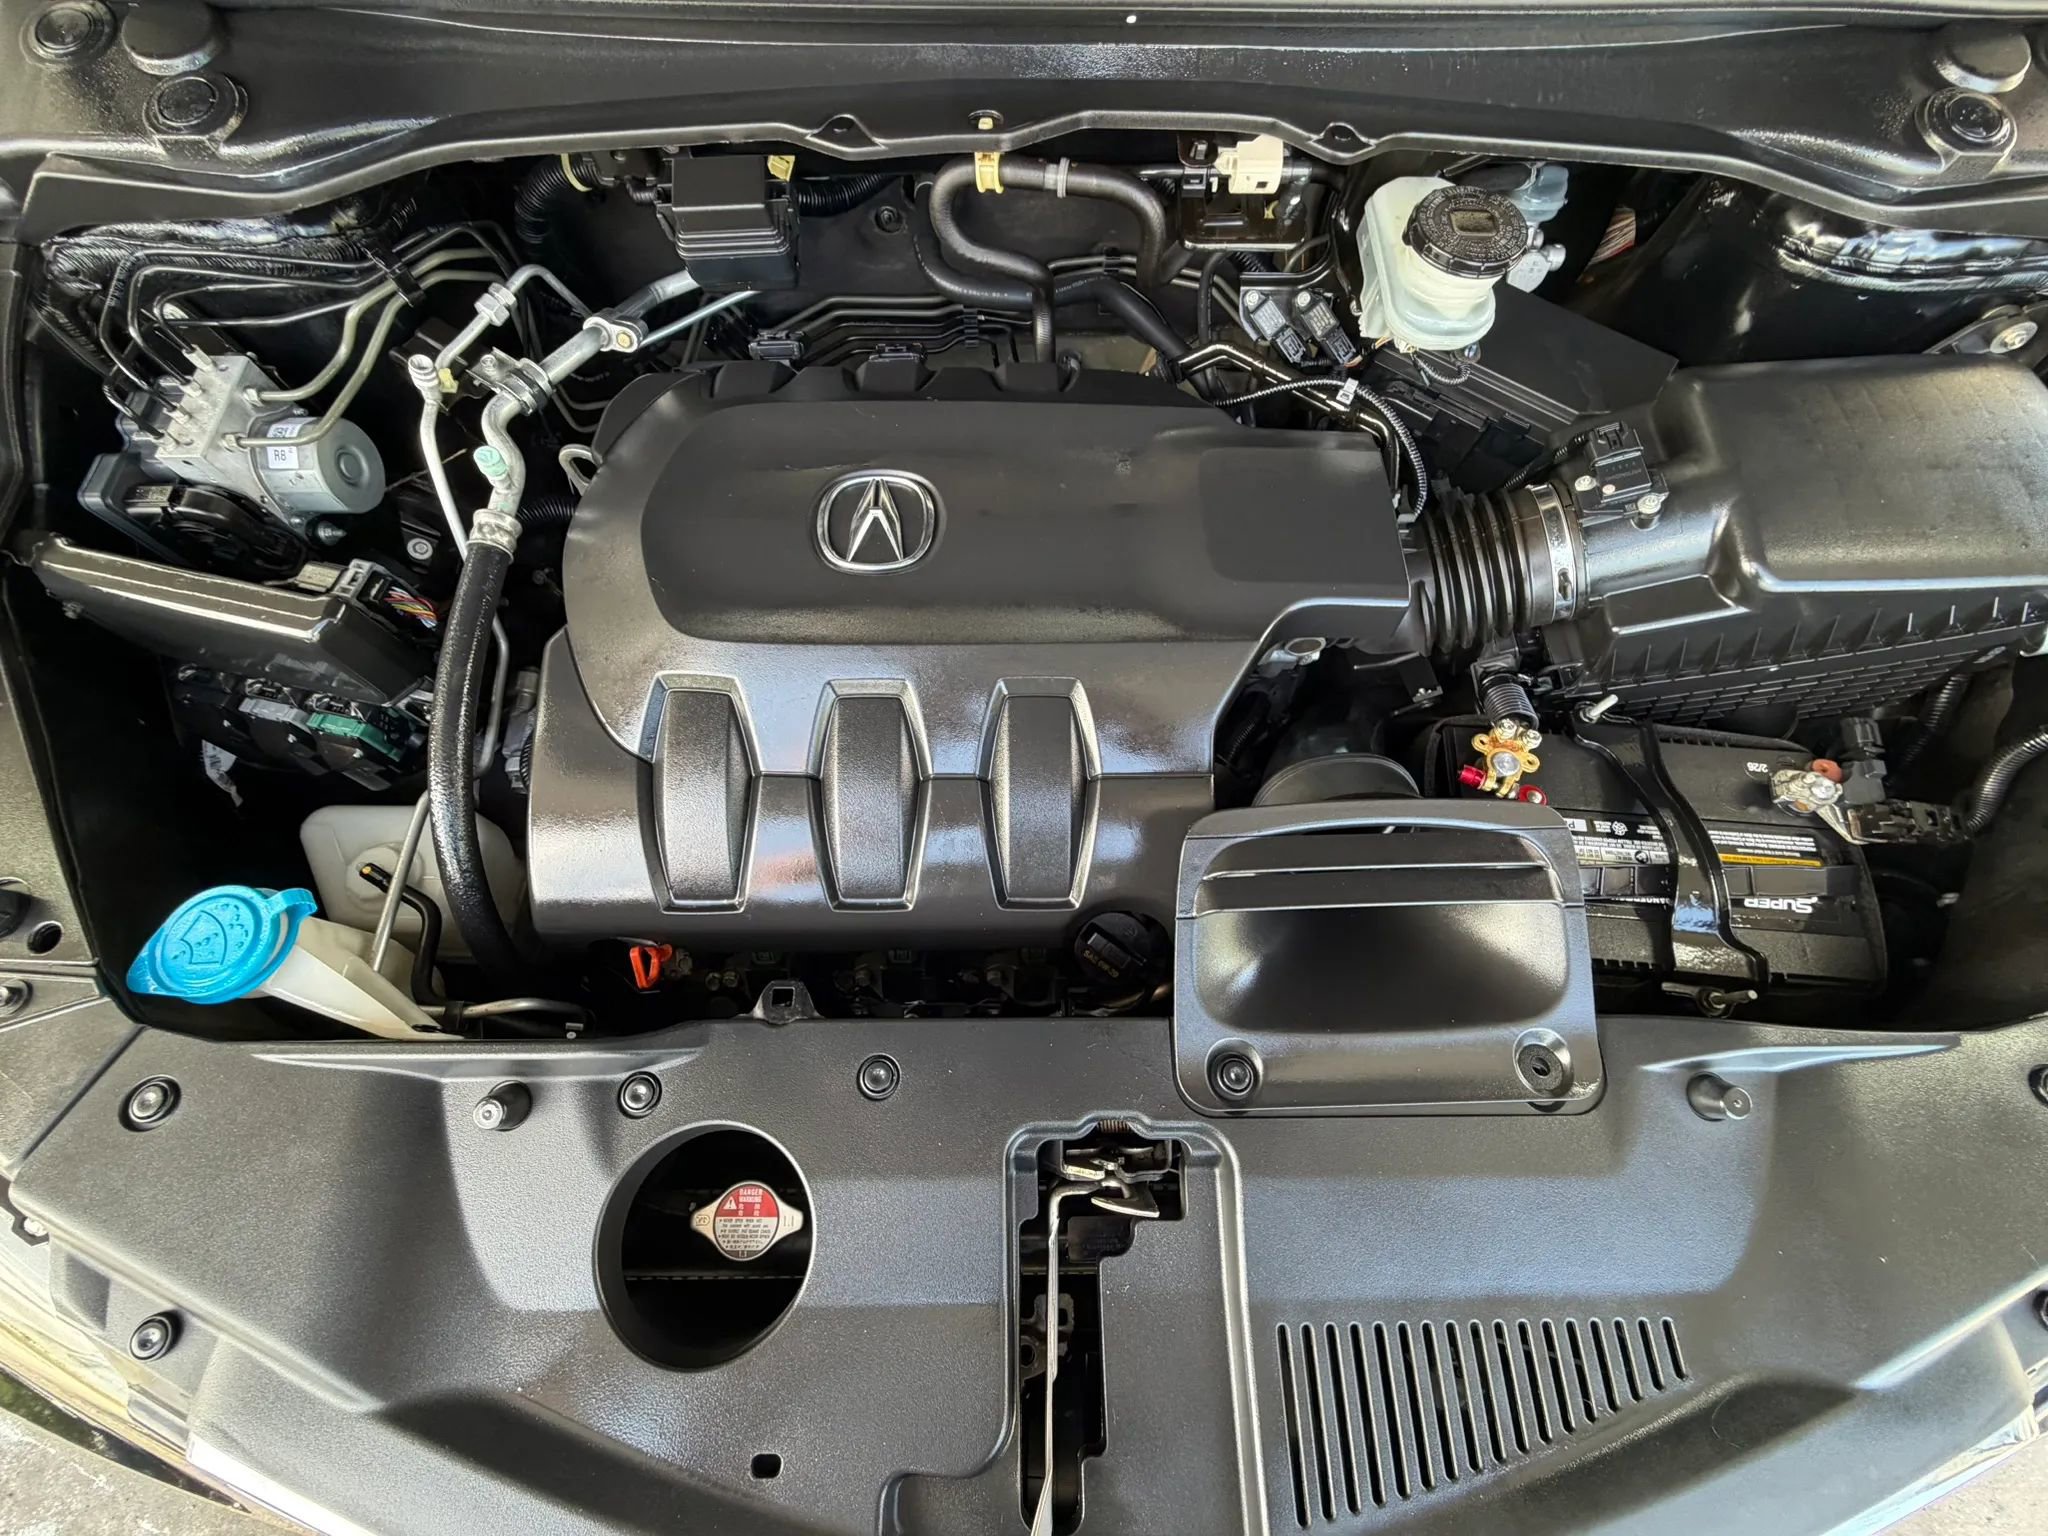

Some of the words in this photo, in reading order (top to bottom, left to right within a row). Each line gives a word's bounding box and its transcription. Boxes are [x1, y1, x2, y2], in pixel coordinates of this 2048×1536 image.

[273, 449, 287, 461] R8
[1743, 896, 1819, 914] SUPER
[739, 1188, 763, 1196] DANGER
